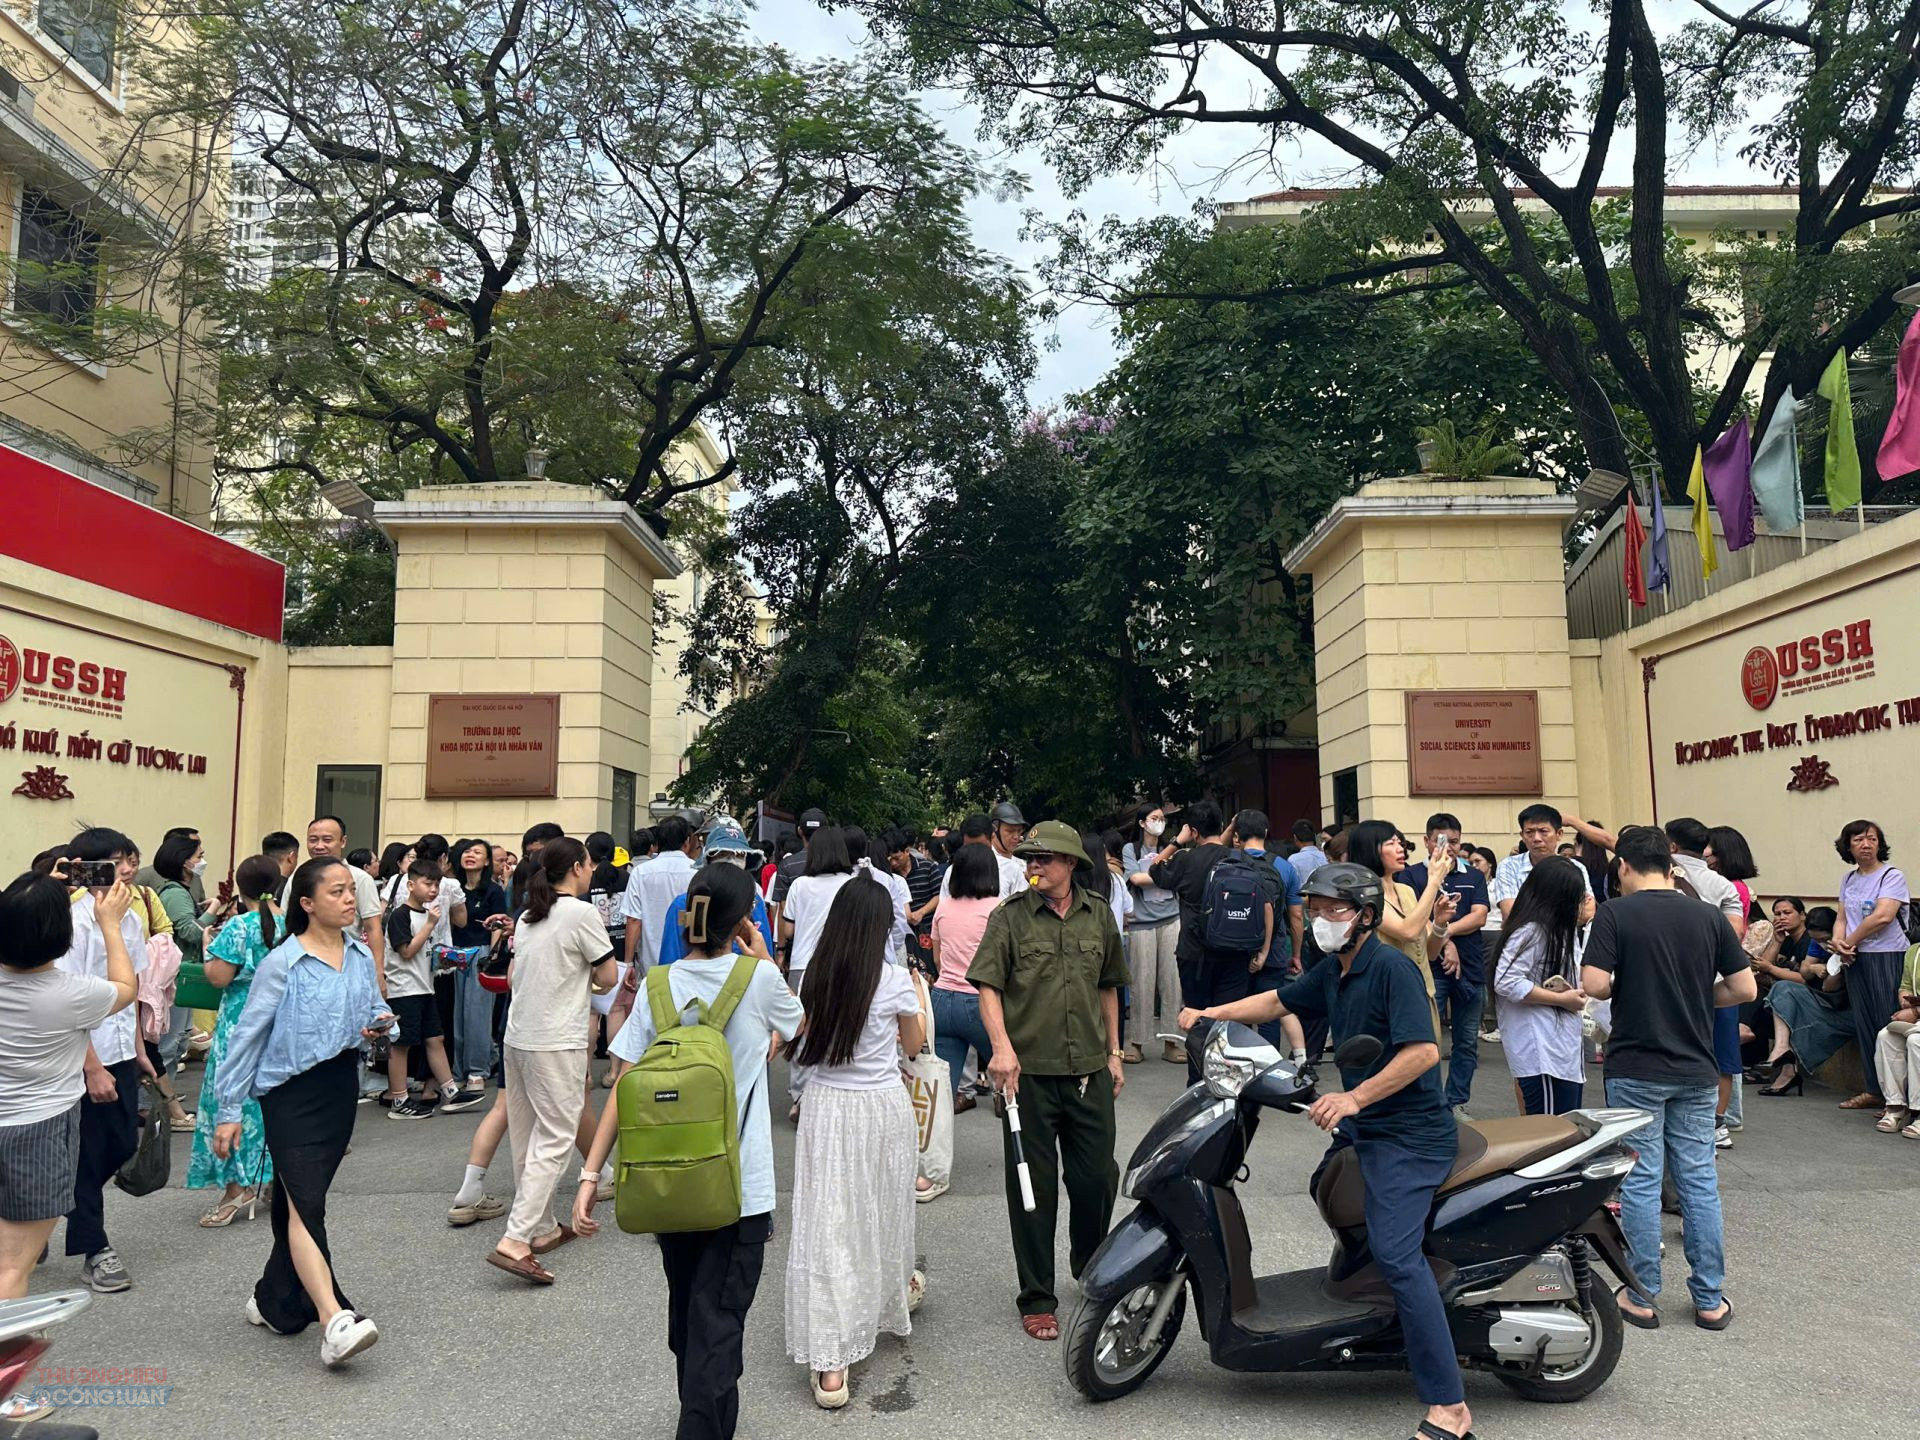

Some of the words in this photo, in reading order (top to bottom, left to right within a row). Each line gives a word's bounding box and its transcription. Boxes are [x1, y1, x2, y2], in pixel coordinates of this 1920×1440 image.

[1776, 619, 1873, 677] USSH
[23, 648, 127, 701] USSH
[1455, 719, 1491, 729] UNIVERSITY
[463, 725, 491, 737] TRƯỜNG
[440, 742, 458, 752] KHOA
[460, 742, 473, 754] HỌC
[1420, 741, 1442, 751] SOCIAL
[1444, 741, 1475, 751] SCIENCES
[1478, 742, 1490, 751] AND
[1492, 741, 1531, 751] HUMANITIES
[135, 745, 184, 772] TƯƠNG
[188, 754, 207, 774] LAI
[1227, 910, 1247, 918] USTH
